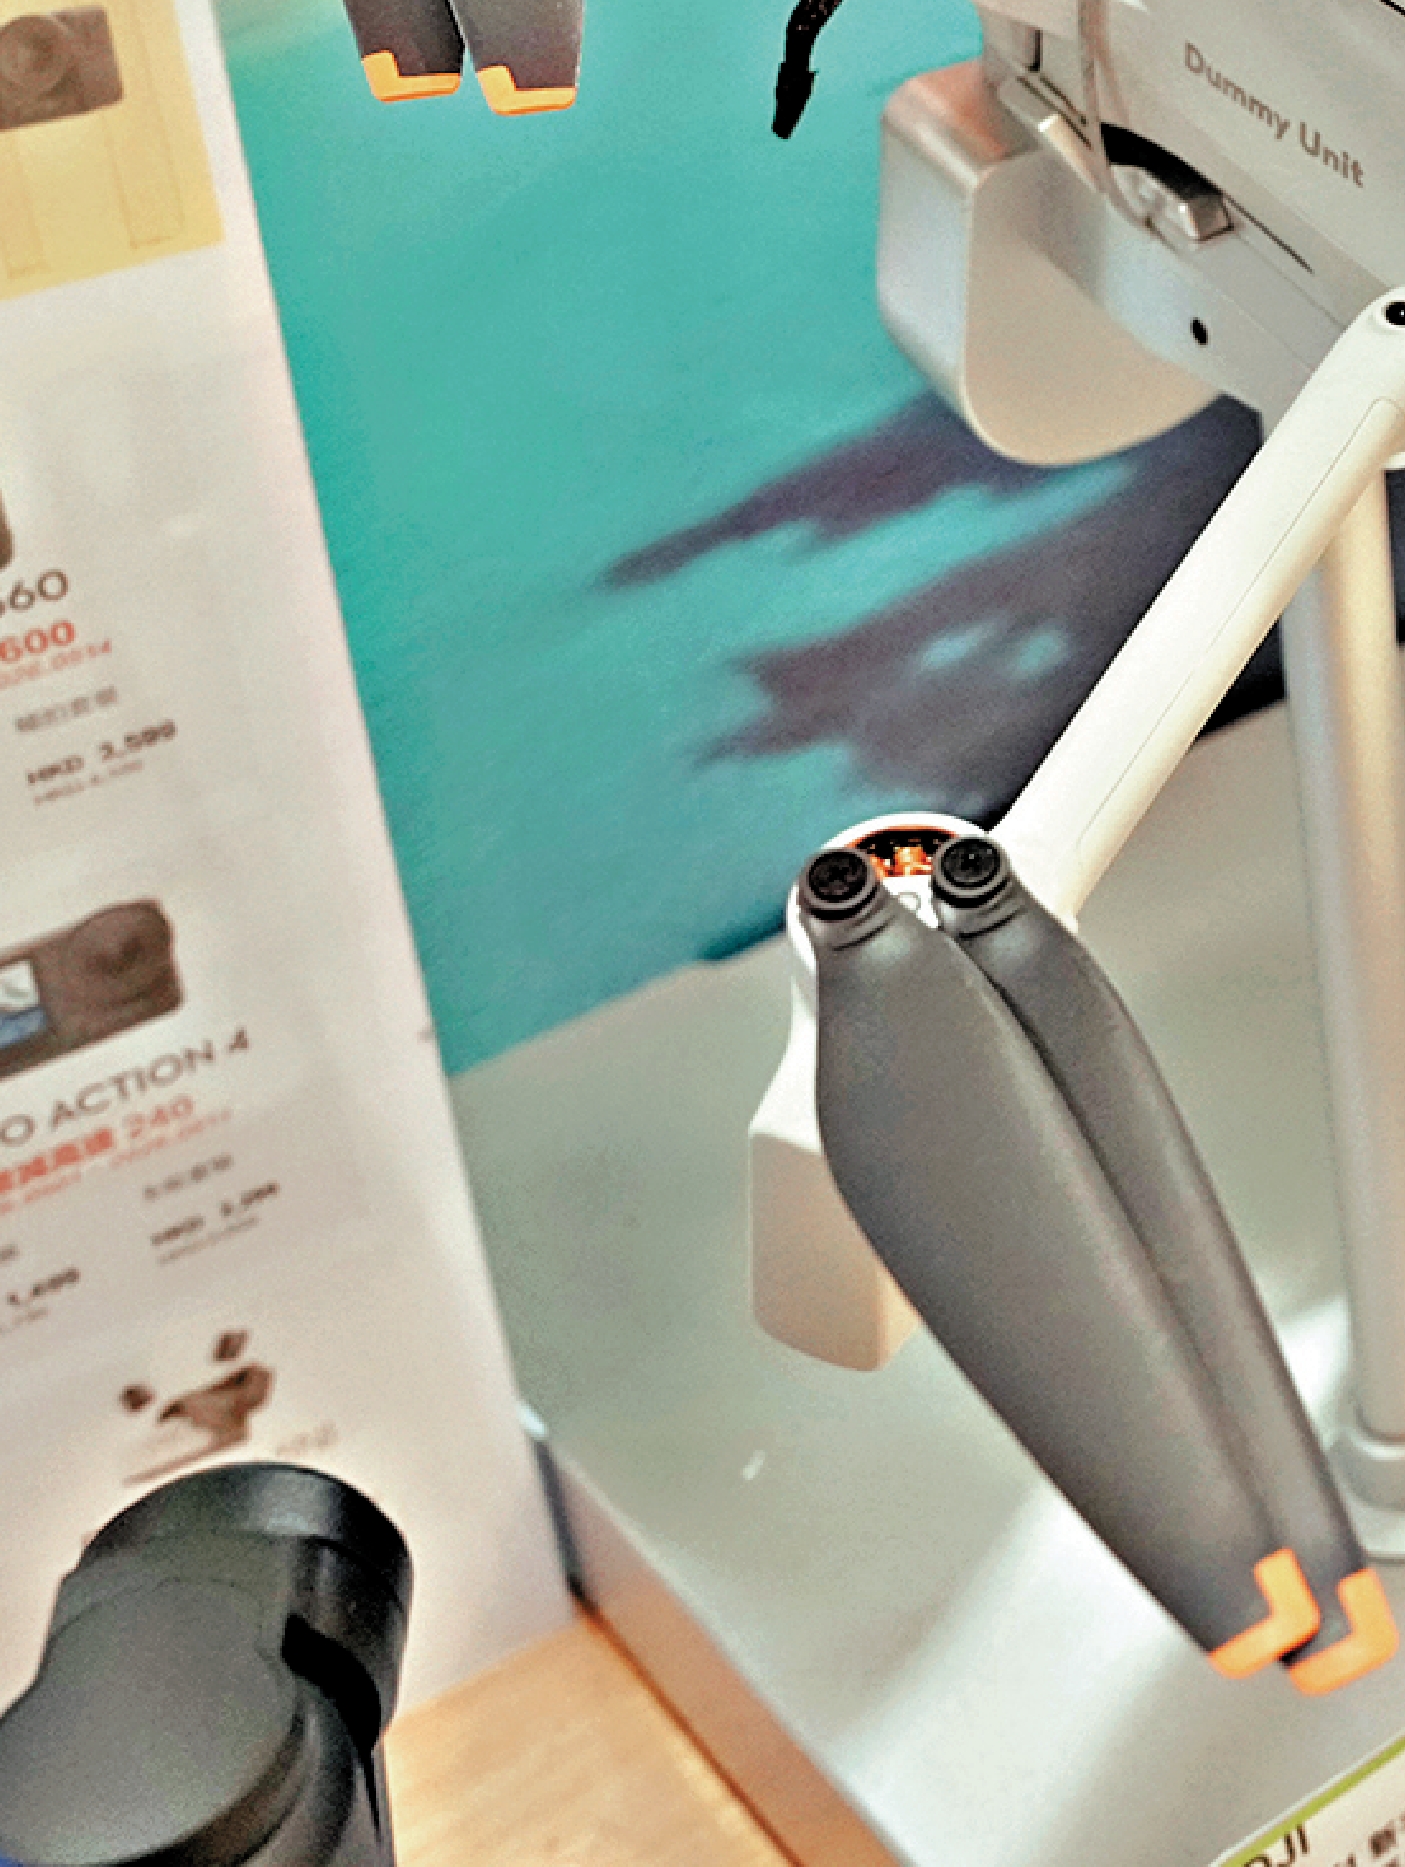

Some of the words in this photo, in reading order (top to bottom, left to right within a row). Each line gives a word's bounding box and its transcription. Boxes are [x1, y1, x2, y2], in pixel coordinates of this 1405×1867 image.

[1184, 40, 1291, 141] Dummy
[1300, 121, 1364, 189] Unit
[0, 567, 69, 619] 60
[50, 1037, 215, 1132] ACTION
[226, 1025, 250, 1054] 4
